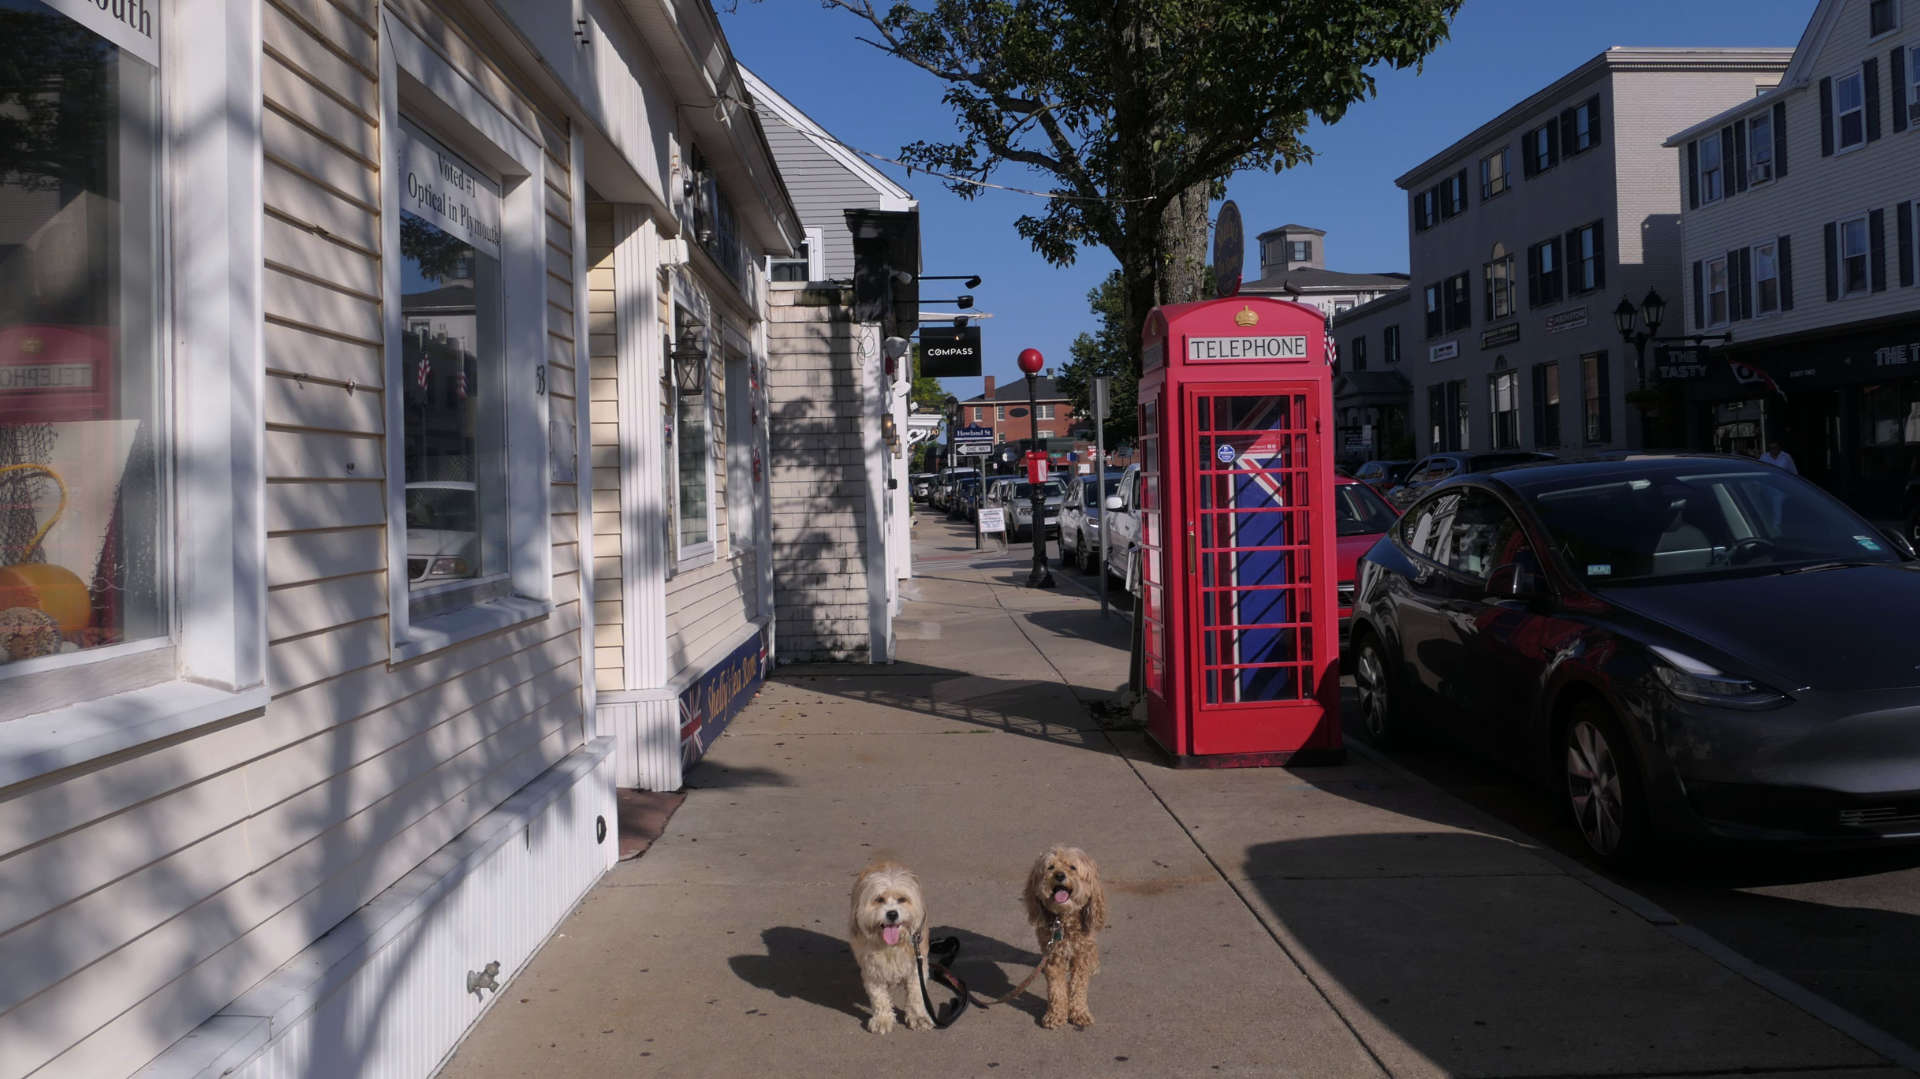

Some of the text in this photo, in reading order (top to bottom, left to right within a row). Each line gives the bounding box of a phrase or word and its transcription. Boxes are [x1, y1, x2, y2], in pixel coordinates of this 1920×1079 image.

[437, 152, 476, 199] Voted #1
[408, 172, 500, 247] Optical in Plymouth
[927, 348, 974, 357] COMPASS
[1190, 337, 1305, 359] TELEPHONE
[1668, 350, 1697, 363] THE
[1874, 345, 1907, 366] THE
[536, 364, 546, 397] 53
[1658, 365, 1707, 378] TASTY
